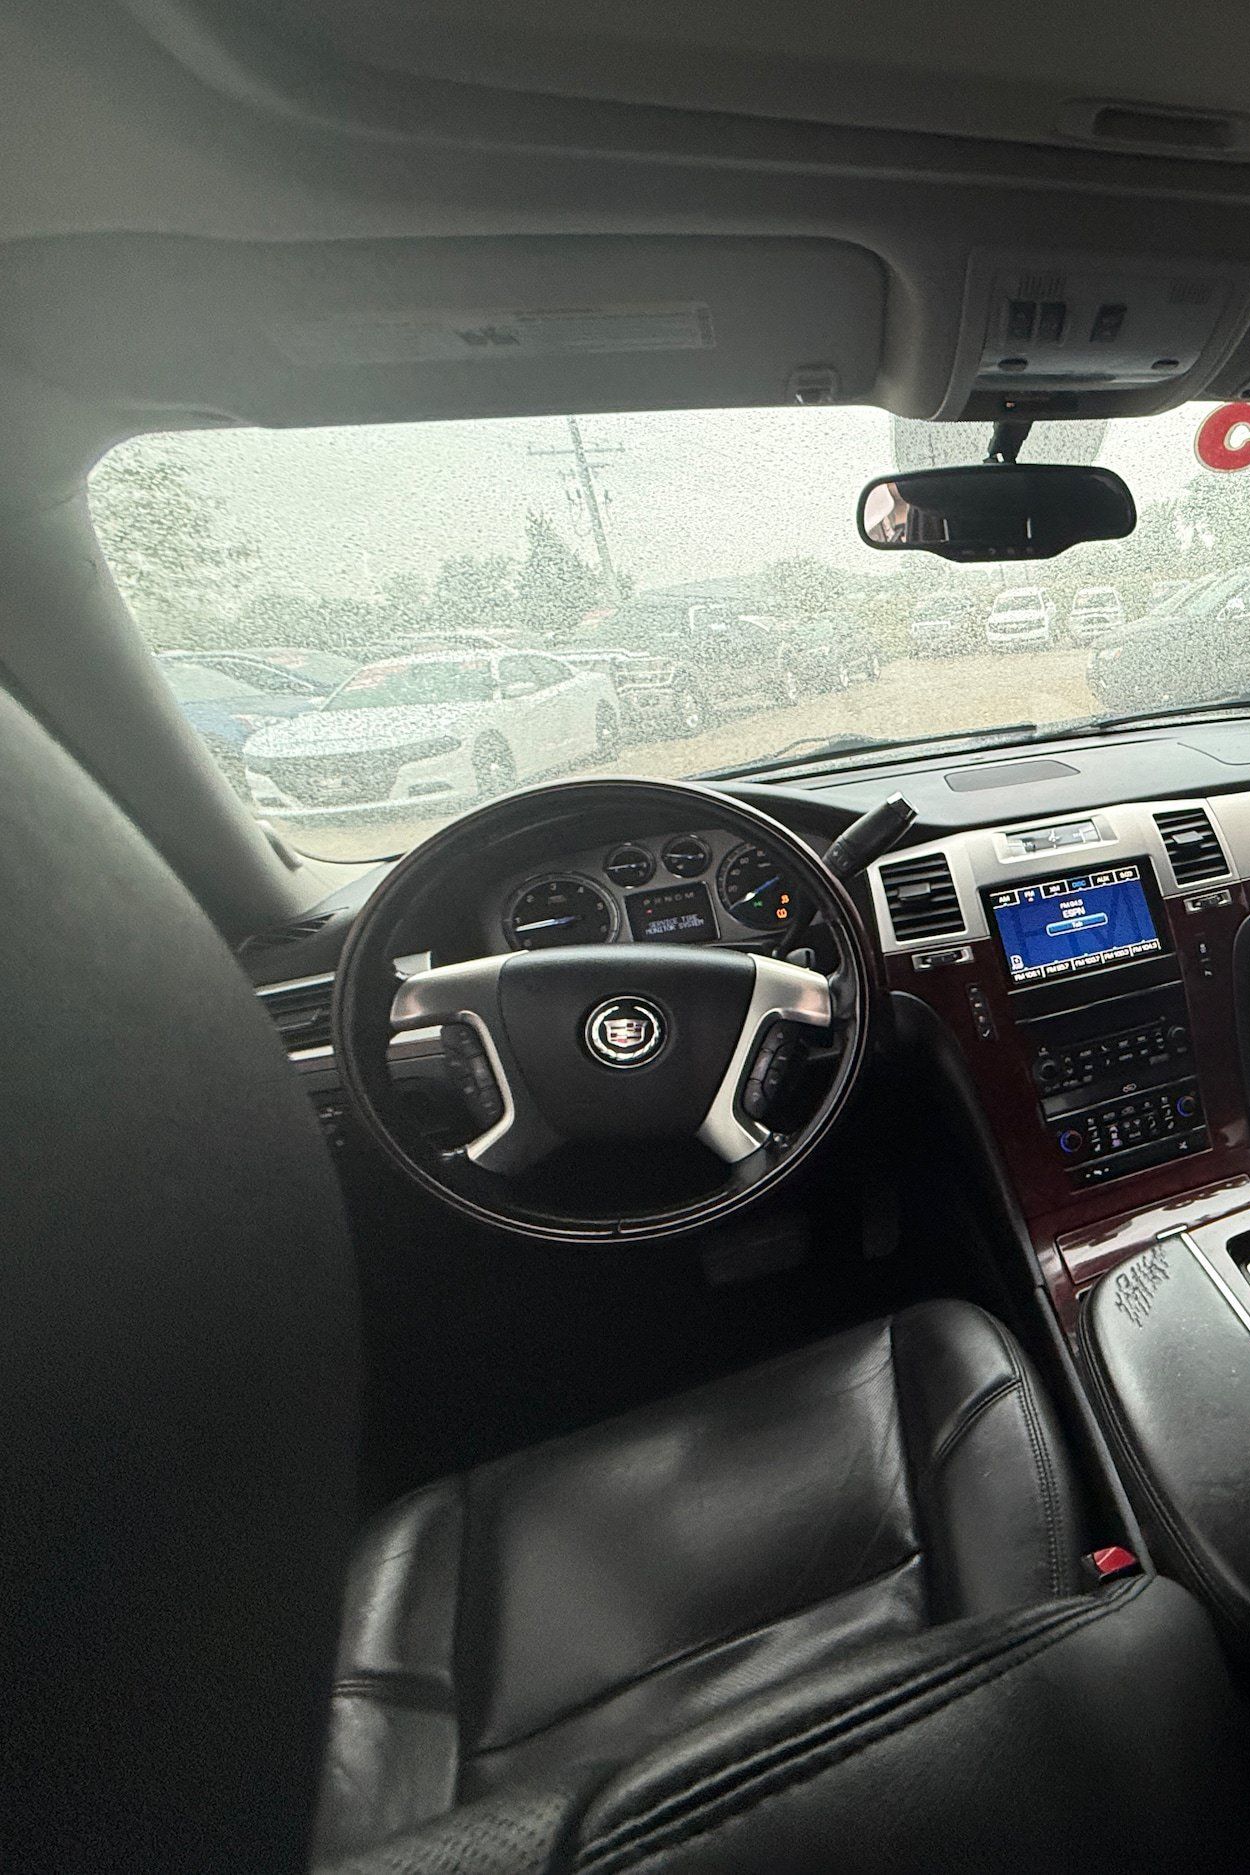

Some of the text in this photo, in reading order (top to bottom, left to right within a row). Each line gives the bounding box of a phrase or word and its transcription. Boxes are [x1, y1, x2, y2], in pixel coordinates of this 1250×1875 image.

[1096, 875, 1110, 883] AUX
[1049, 885, 1061, 893] XM
[1023, 890, 1036, 898] FM
[998, 895, 1011, 903] AM
[1062, 906, 1086, 919] ESPN
